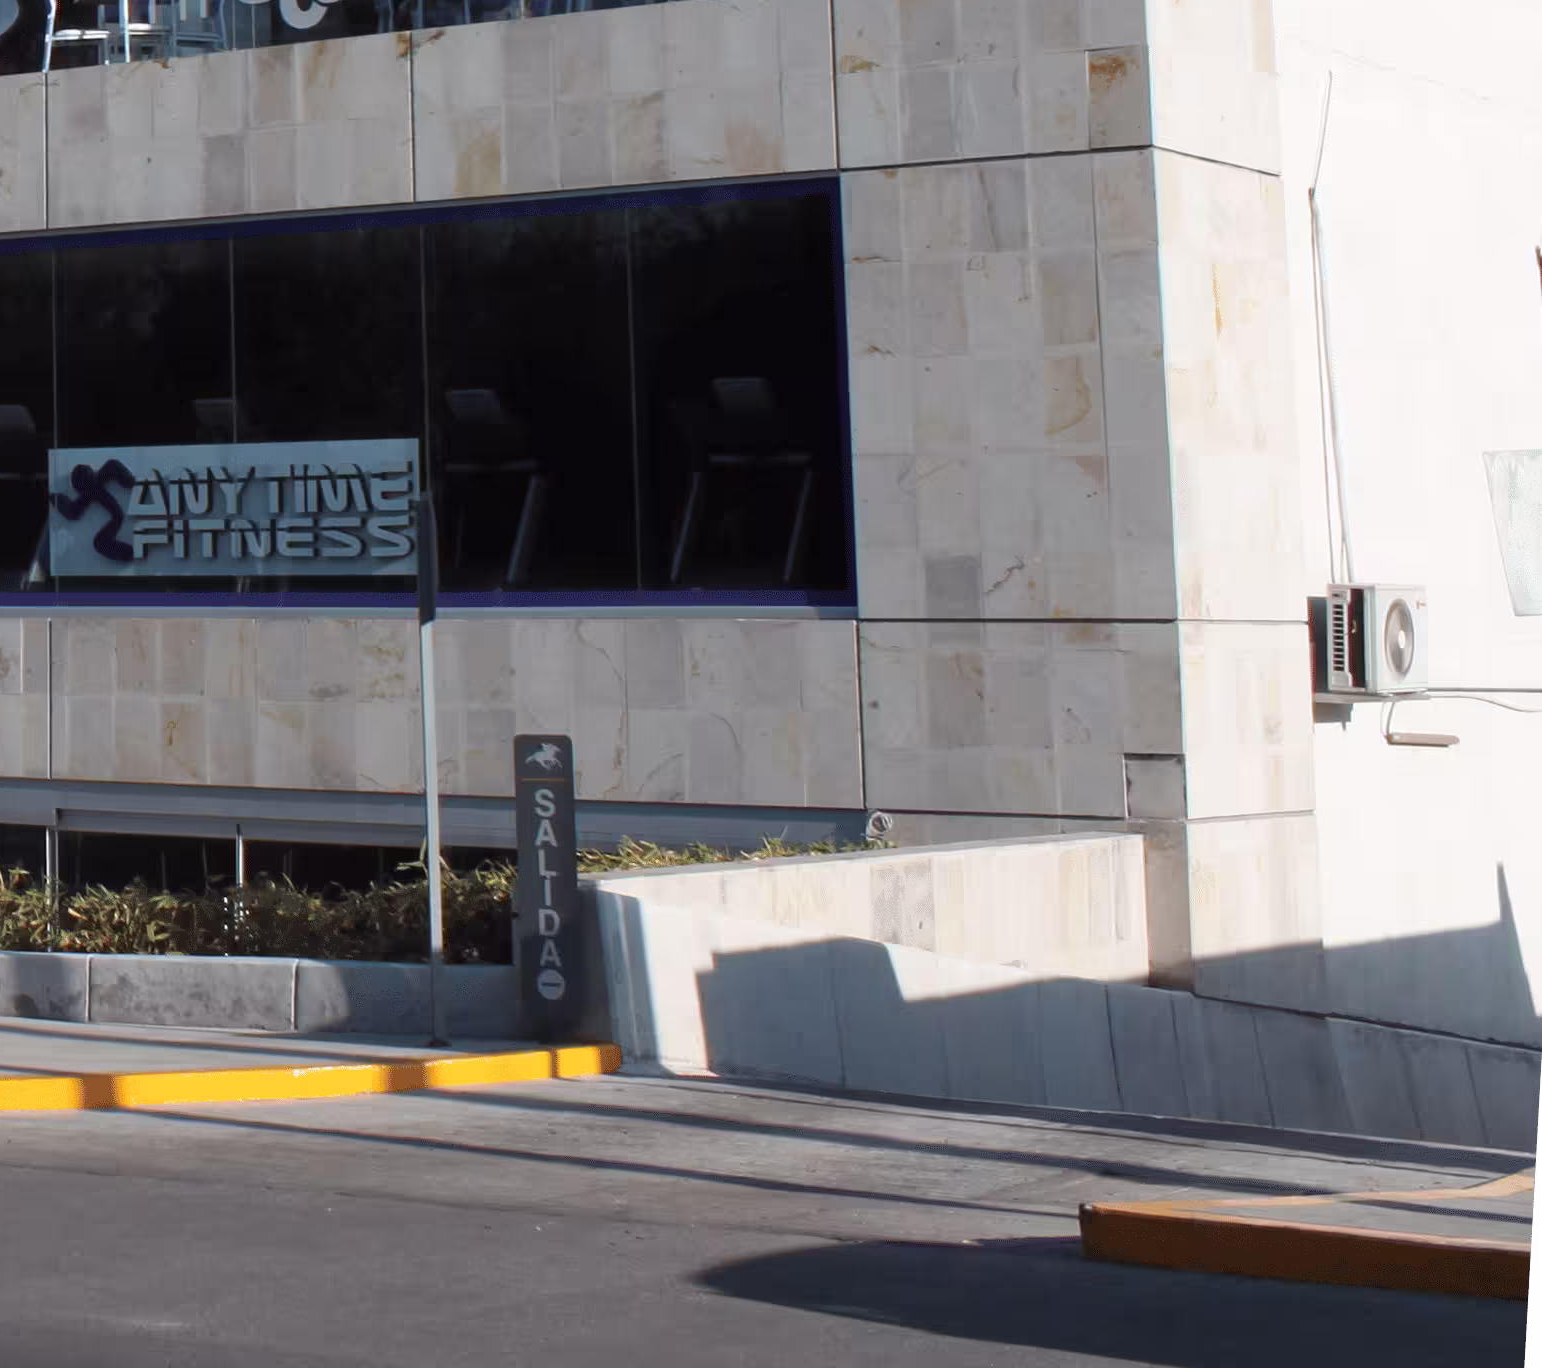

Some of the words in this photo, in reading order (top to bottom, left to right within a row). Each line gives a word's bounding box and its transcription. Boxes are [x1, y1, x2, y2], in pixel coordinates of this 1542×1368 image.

[126, 464, 411, 516] ANYTIME
[131, 517, 413, 559] FITNESS
[534, 788, 562, 967] SALIDA
